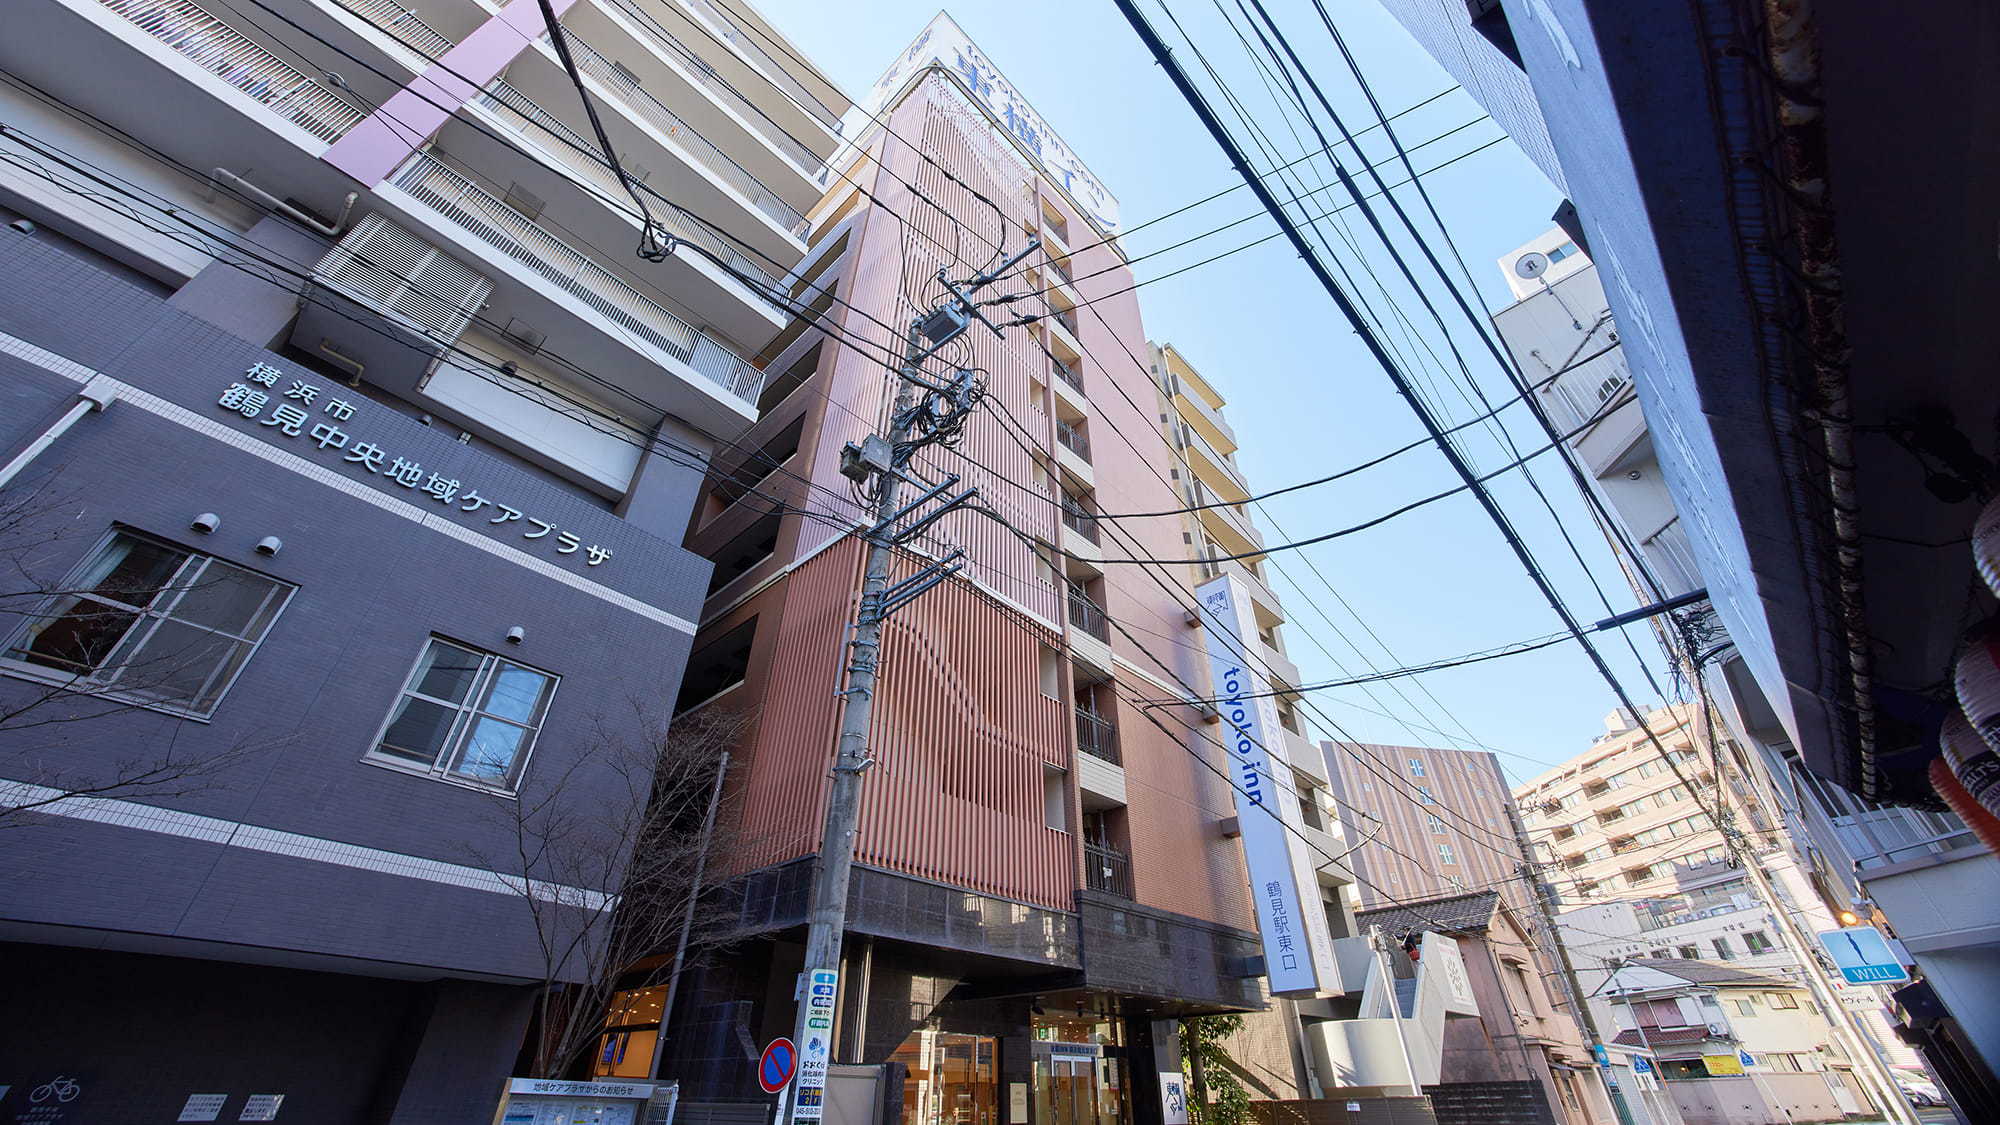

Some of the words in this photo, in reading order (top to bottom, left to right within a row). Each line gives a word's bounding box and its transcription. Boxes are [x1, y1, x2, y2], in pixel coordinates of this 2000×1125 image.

[245, 360, 358, 422] 横浜市
[217, 381, 614, 567] 鶴見中央地域ケアプラザ
[1223, 666, 1254, 754] toyoko
[1240, 757, 1264, 807] inn
[1265, 880, 1297, 972] 鶴見駅東口
[1853, 967, 1897, 980] WILL
